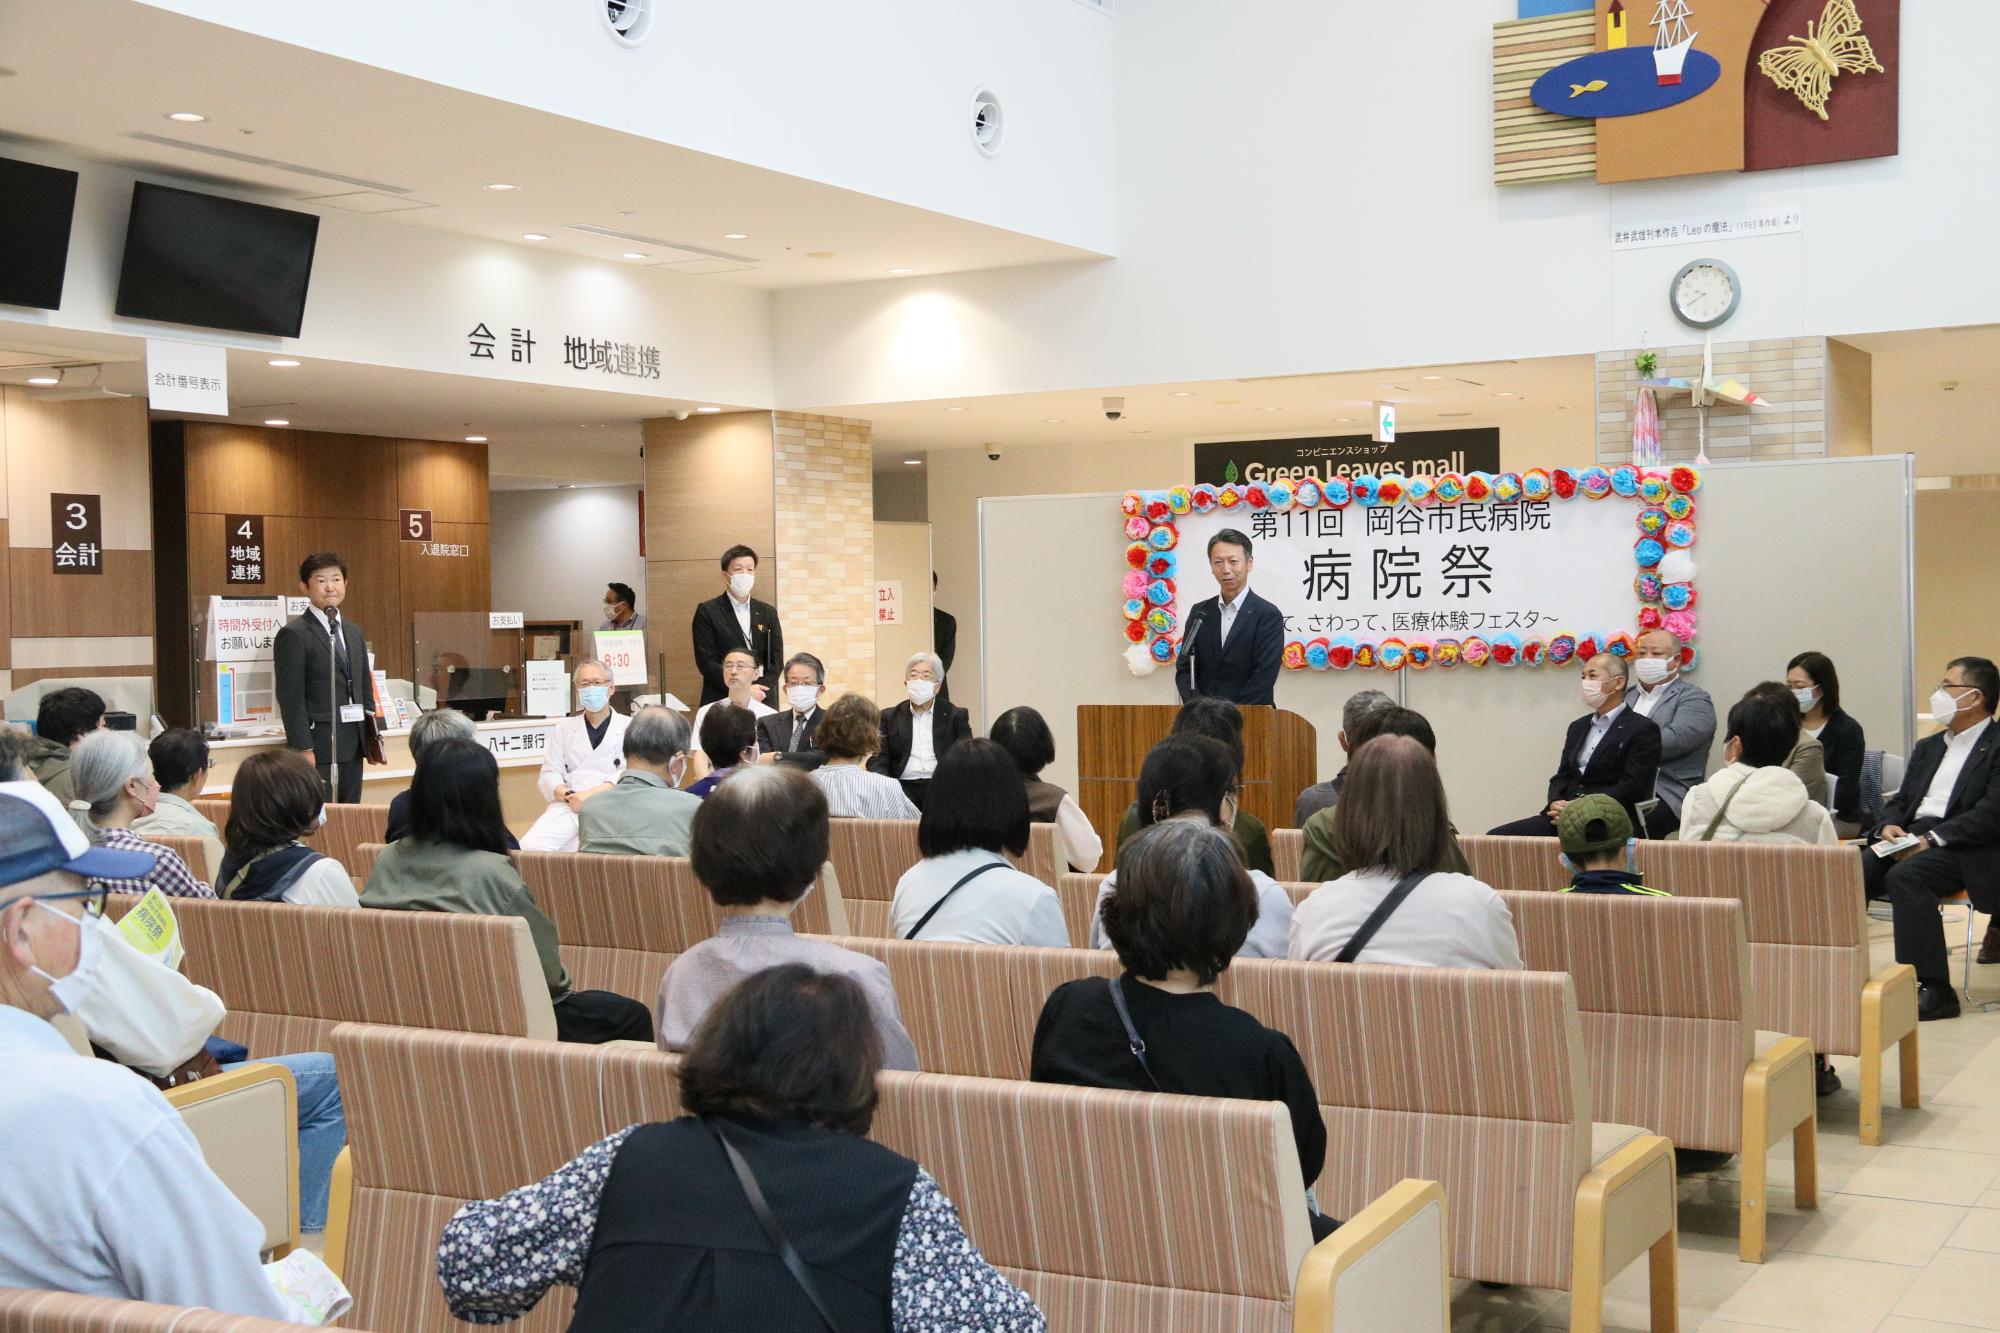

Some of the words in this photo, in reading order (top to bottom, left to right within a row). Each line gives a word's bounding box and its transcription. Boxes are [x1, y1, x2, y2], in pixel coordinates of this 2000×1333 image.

[468, 322, 537, 364] 会計
[563, 335, 661, 380] 地域連携
[153, 372, 222, 392] 会計番号表示
[1296, 443, 1389, 457] コンビニエンスショップ
[1245, 462, 1319, 484] Green
[1412, 450, 1465, 477] mall
[65, 503, 88, 531] 3
[408, 513, 424, 538] 5
[1250, 509, 1344, 541] 第11回
[1366, 500, 1552, 537] 岡谷市民病院
[237, 520, 253, 540] 4
[55, 541, 100, 567] 会計
[229, 545, 261, 563] 地域
[420, 543, 469, 557] 入退院窓口
[230, 564, 262, 581] 連携
[1301, 543, 1494, 602] 病院祭
[878, 587, 895, 601] 立入
[493, 615, 521, 626] お支払い
[878, 607, 895, 622] 禁止
[218, 617, 284, 632] 時間外受付へ
[221, 636, 276, 650] お願いしま
[604, 653, 630, 668] 8:30
[488, 733, 546, 753] 八十二銀行
